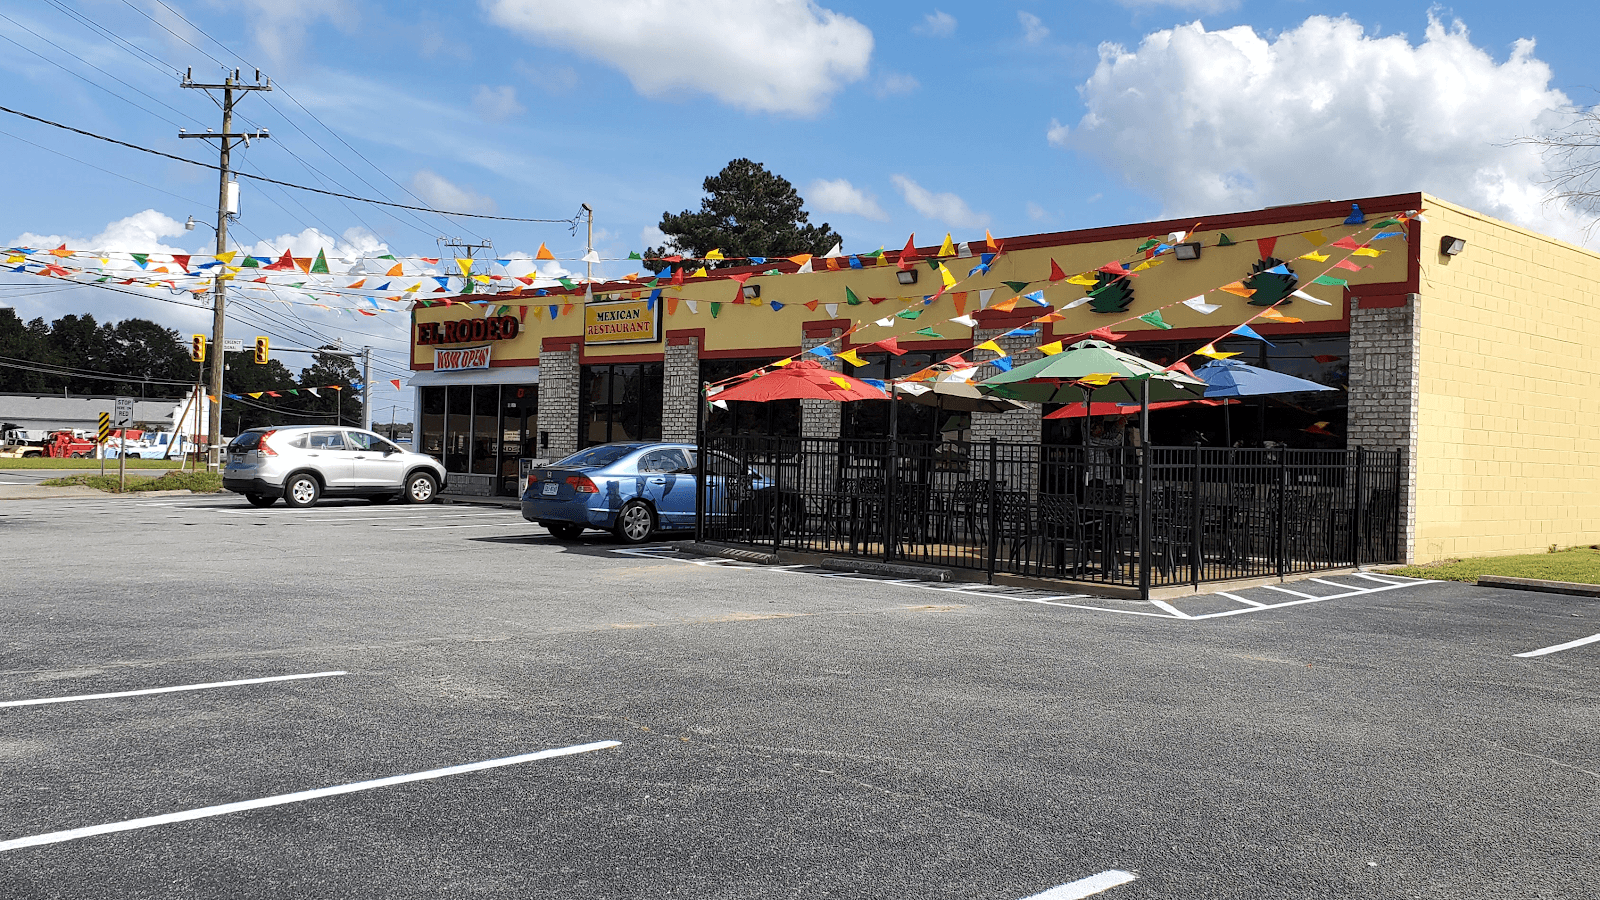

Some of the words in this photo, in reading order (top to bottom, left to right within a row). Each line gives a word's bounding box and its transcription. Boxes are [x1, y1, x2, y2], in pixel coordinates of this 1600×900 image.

[597, 309, 641, 322] MEXICAN
[417, 322, 443, 345] EL
[443, 315, 519, 343] RODEO
[588, 321, 651, 335] RESTAURANT
[438, 351, 462, 369] NOW
